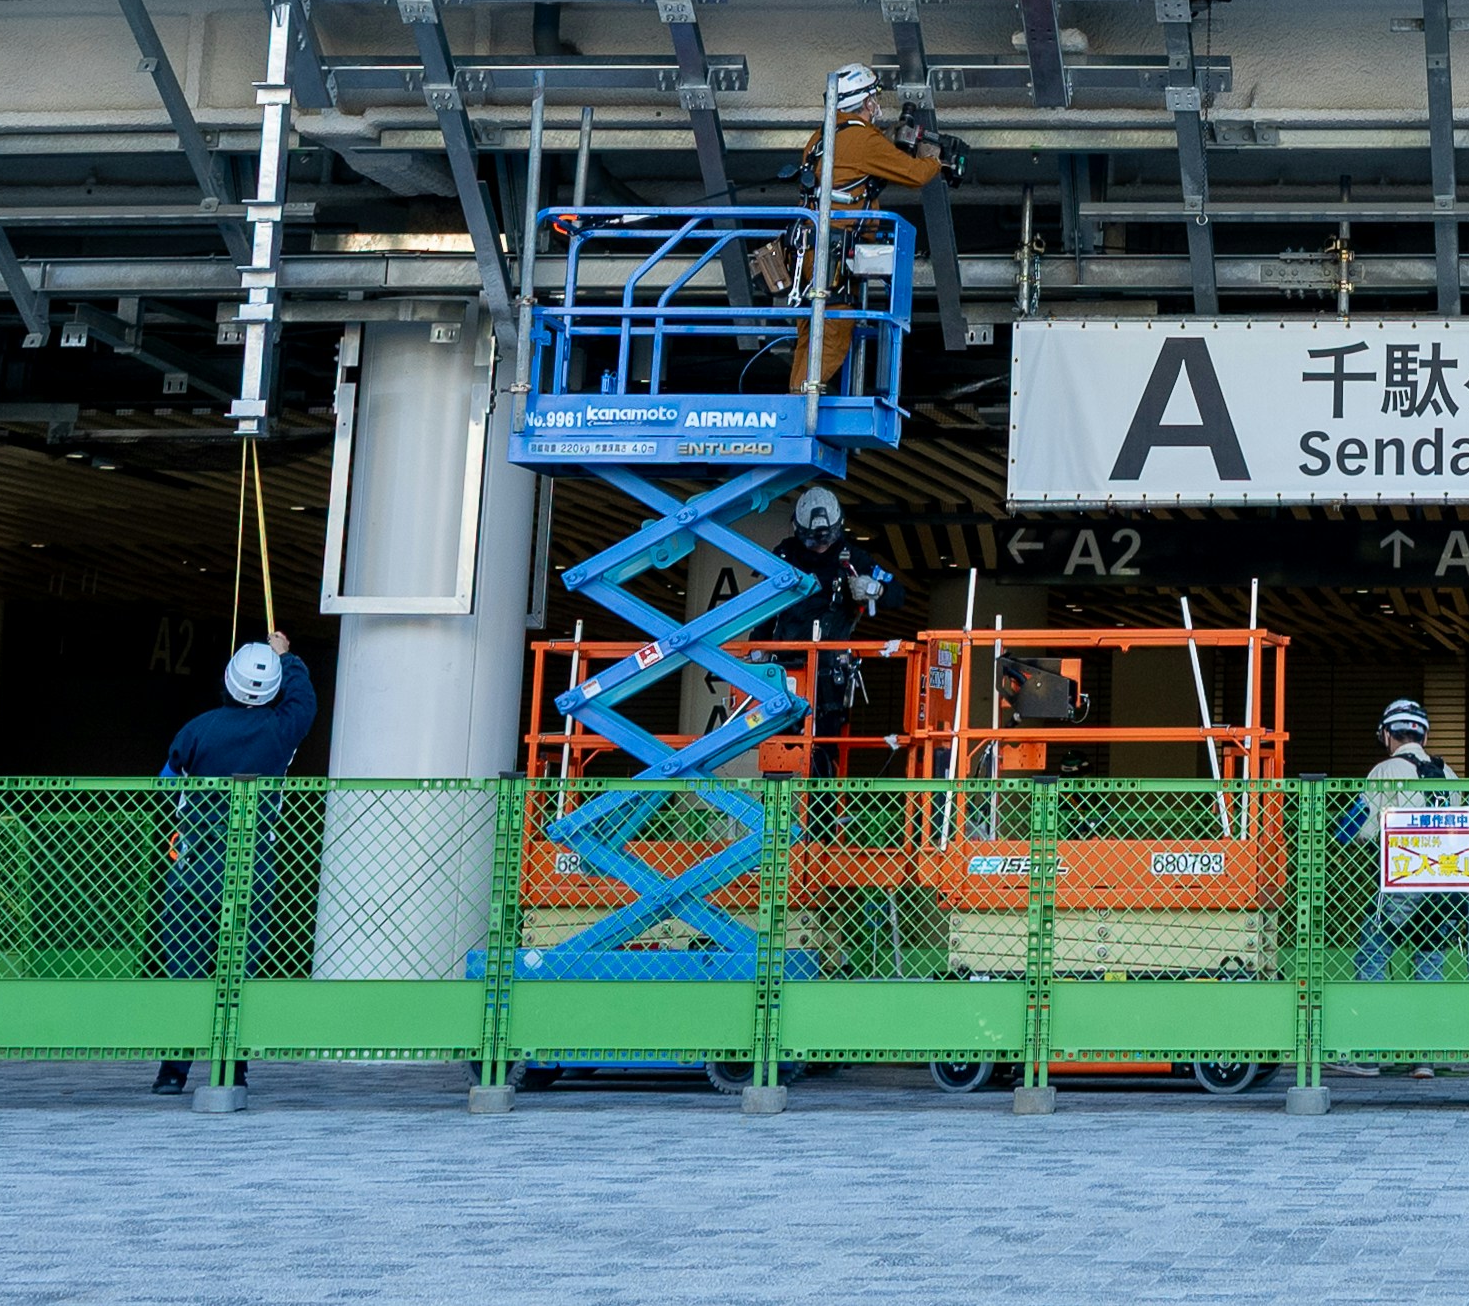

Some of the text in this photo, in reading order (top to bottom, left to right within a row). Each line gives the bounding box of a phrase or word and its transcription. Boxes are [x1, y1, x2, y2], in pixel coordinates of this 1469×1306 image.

[586, 405, 678, 421] kanamoto
[684, 411, 777, 428] AIRMAN
[1108, 337, 1252, 481] A
[1063, 528, 1141, 575] A2
[147, 615, 195, 675] A2
[1153, 854, 1223, 873] 680793
